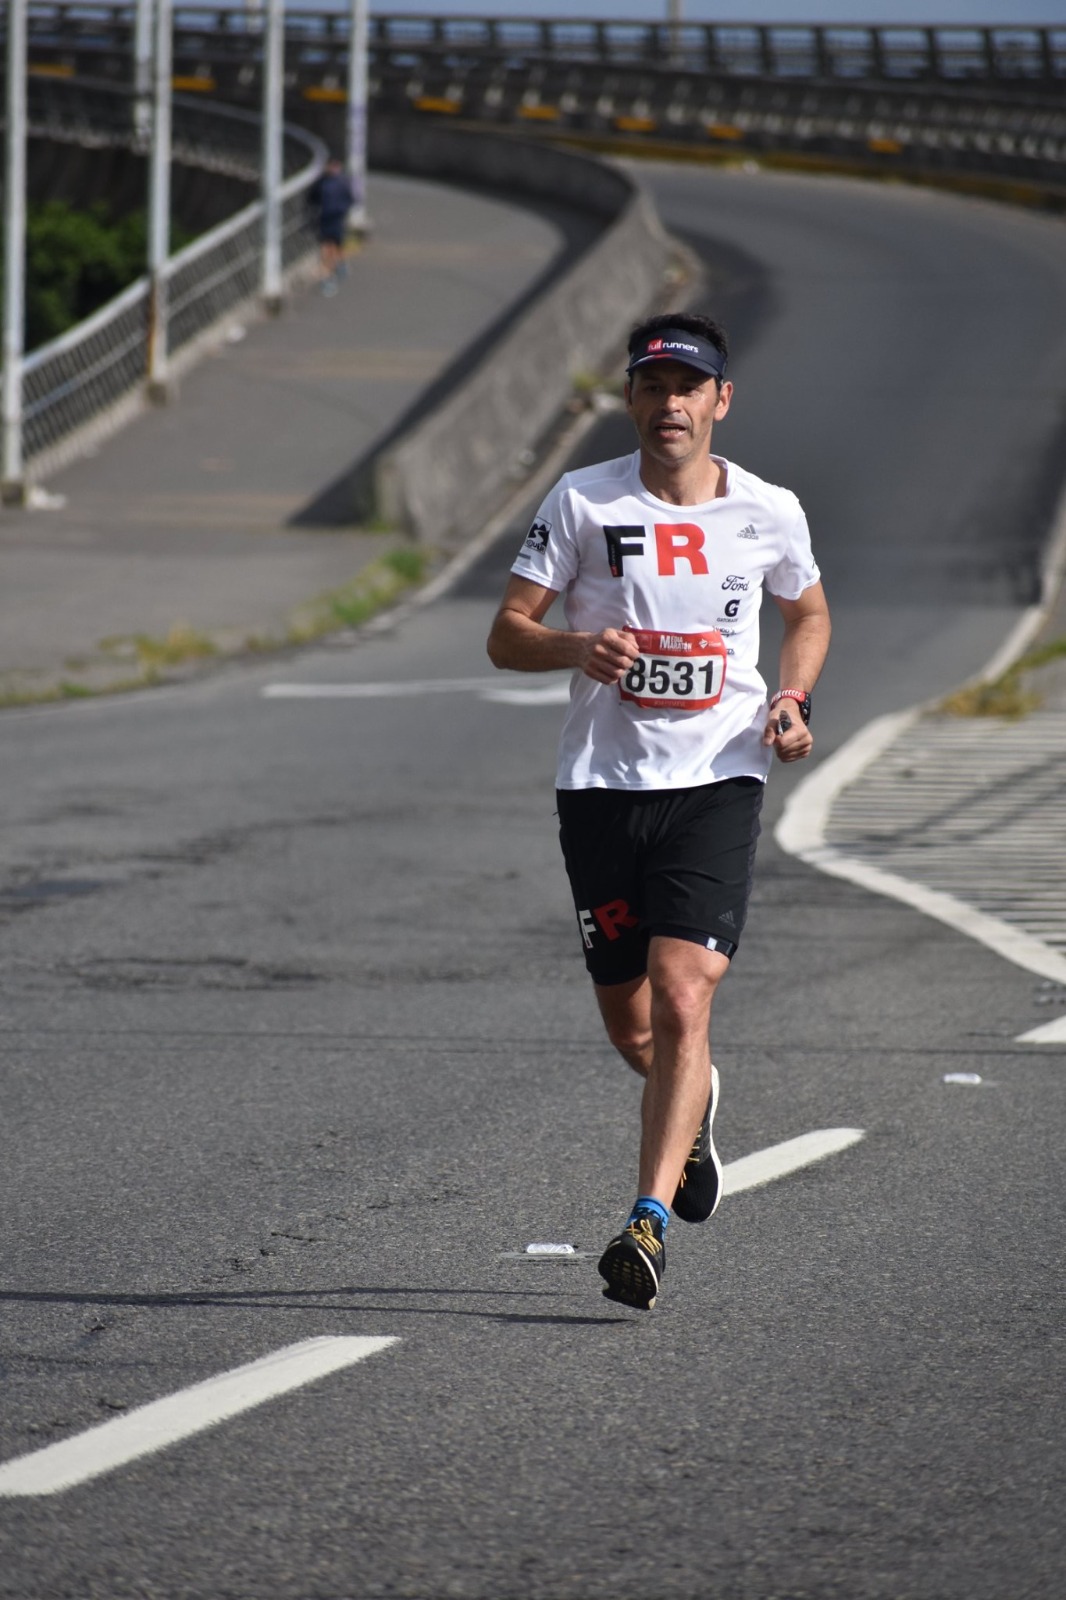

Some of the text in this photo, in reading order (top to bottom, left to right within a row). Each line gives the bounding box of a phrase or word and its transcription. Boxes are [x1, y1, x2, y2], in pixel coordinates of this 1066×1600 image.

[648, 339, 699, 353] full runners
[736, 532, 760, 541] adidas
[603, 523, 709, 577] FR
[721, 574, 750, 592] Ford
[724, 598, 741, 618] G
[625, 657, 713, 696] 8531
[578, 899, 638, 949] FR
